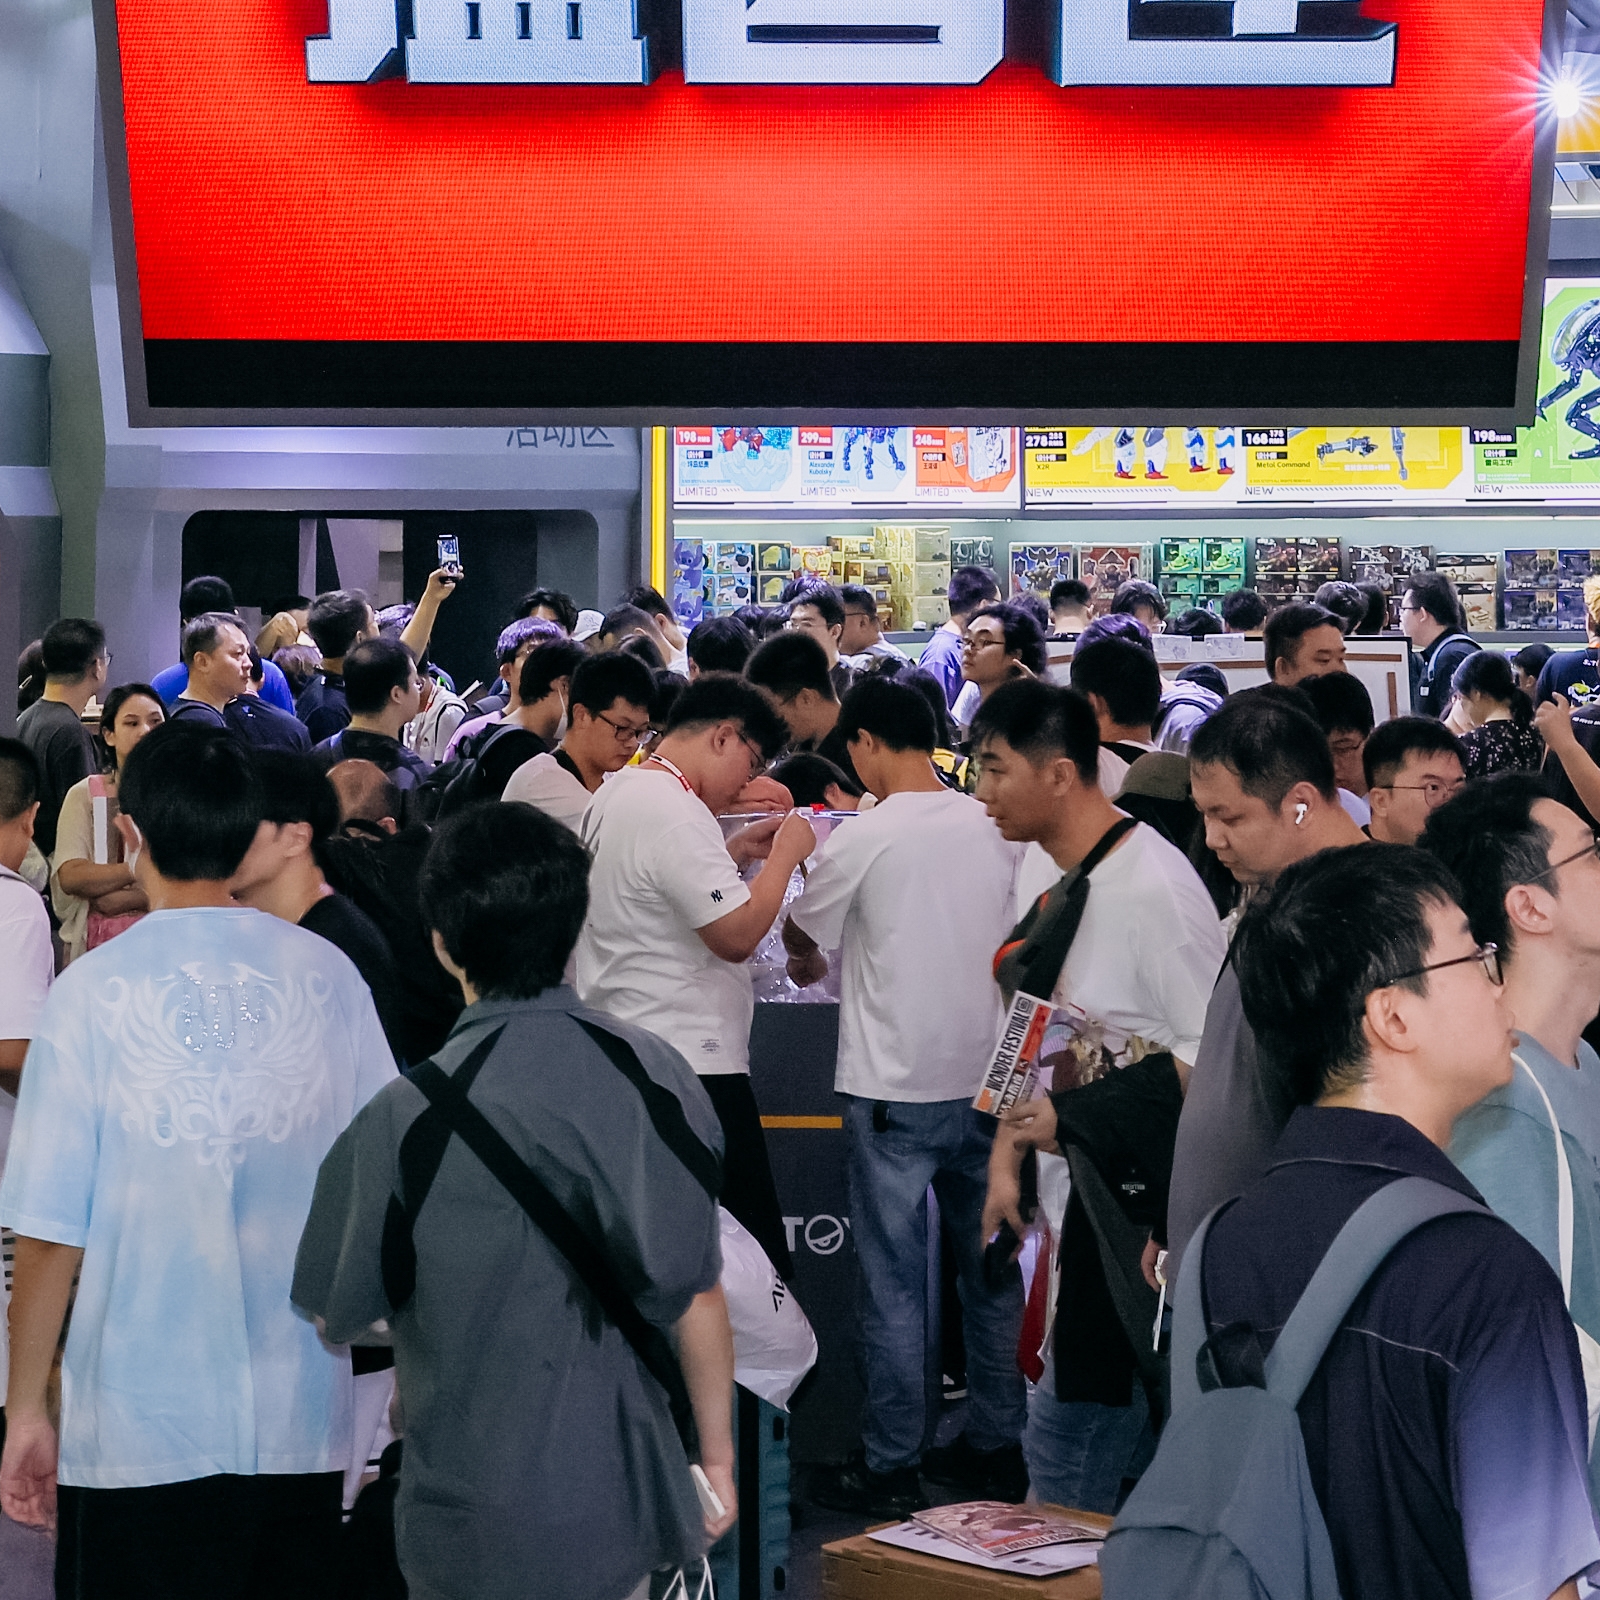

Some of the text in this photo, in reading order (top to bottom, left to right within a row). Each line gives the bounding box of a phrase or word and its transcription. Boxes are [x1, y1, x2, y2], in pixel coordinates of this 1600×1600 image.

[1025, 435, 1048, 447] 278
[1246, 432, 1268, 445] 168
[678, 487, 717, 496] LIMITED
[800, 487, 836, 496] LIMITED
[914, 488, 949, 497] LIMITED
[1026, 488, 1053, 497] NEW
[1245, 487, 1273, 496] NEW
[1474, 485, 1503, 494] NEW
[985, 1051, 1015, 1092] WONDER
[1001, 1009, 1031, 1053] FESTIVAL
